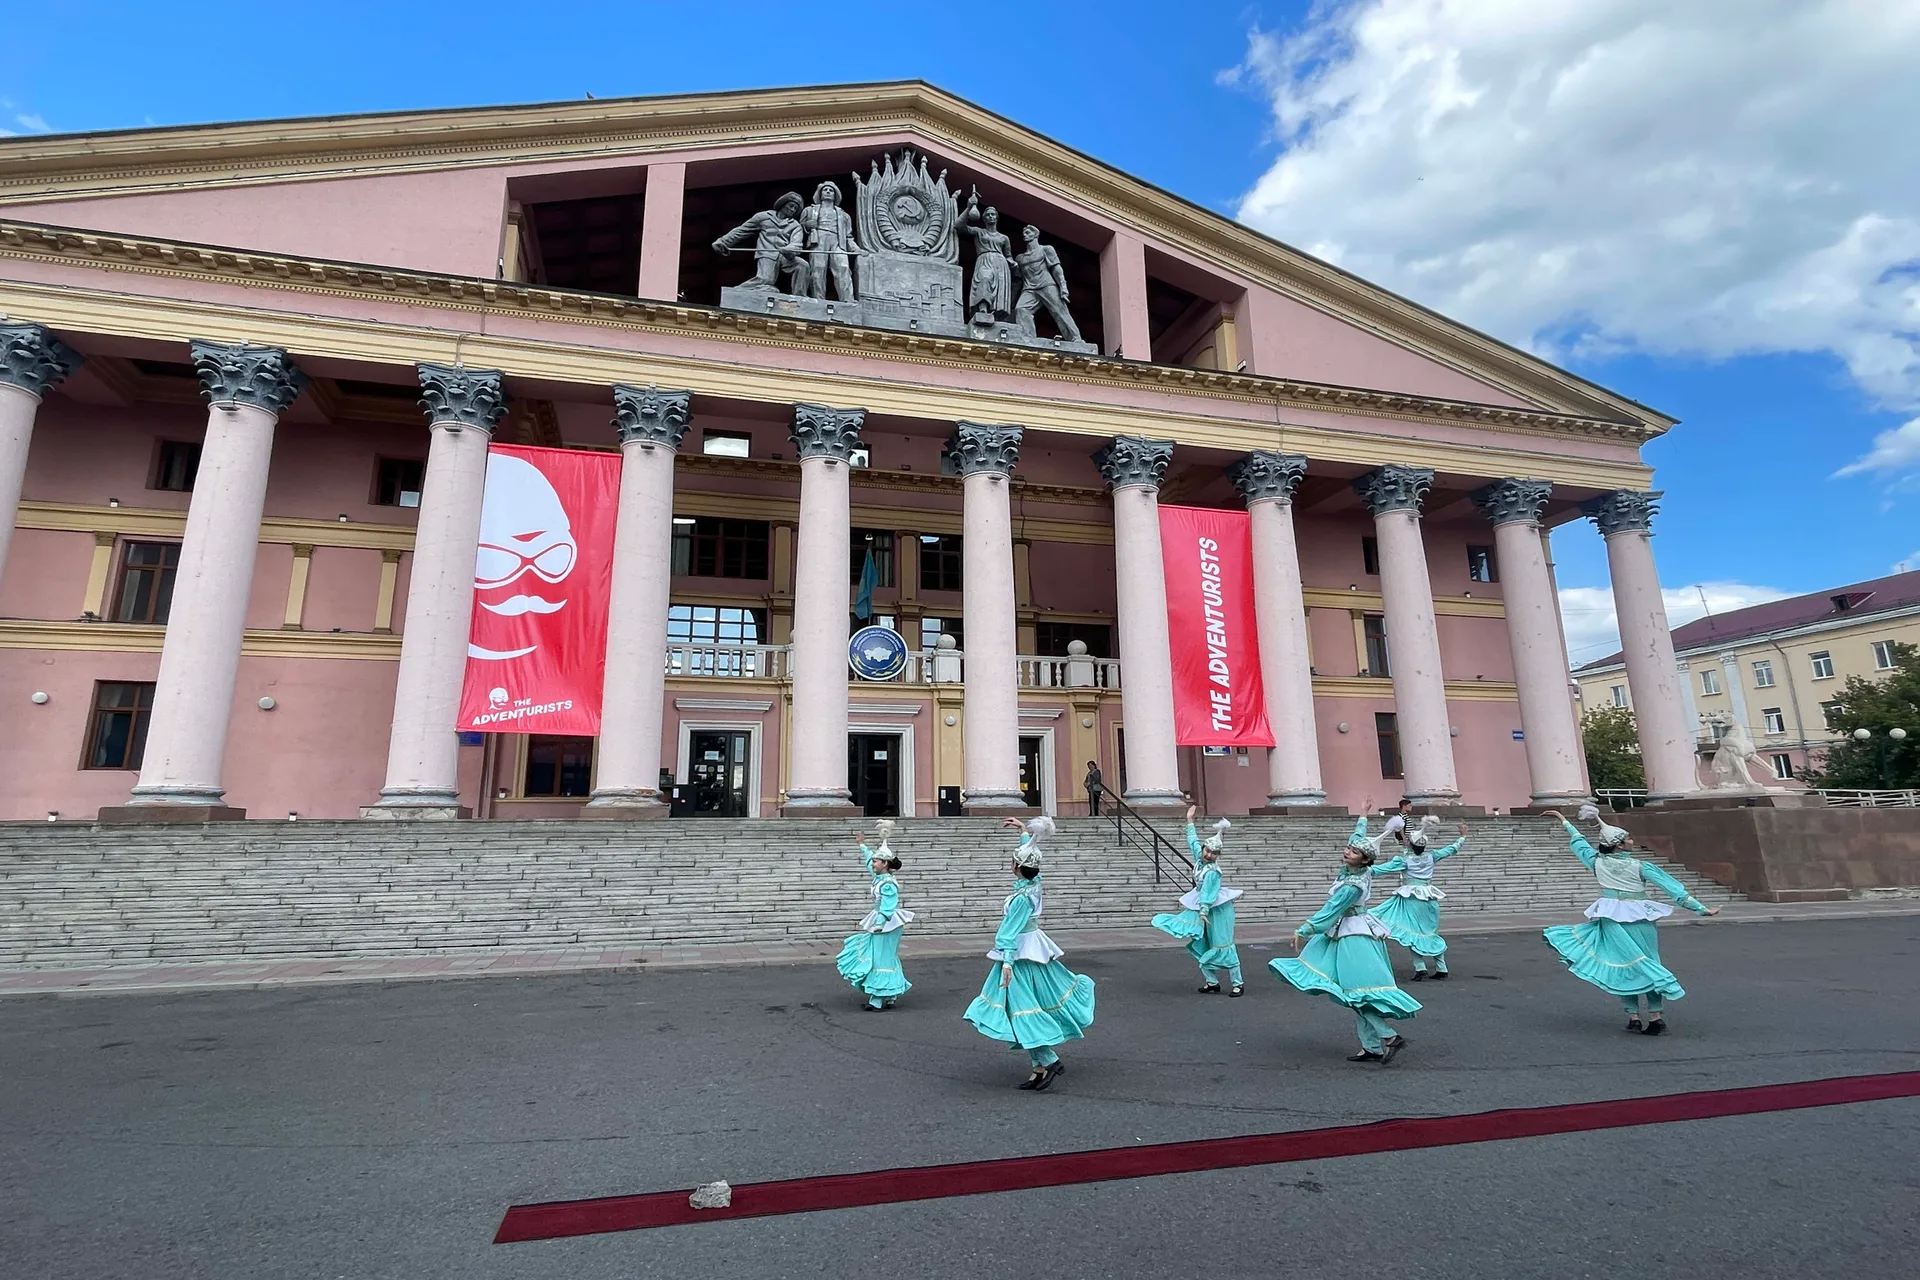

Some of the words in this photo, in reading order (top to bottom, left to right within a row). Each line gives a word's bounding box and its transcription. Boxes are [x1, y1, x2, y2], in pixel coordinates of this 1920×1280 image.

[1199, 537, 1230, 688] ADVENTURISTS
[472, 700, 572, 726] ADVENTURISTS
[514, 698, 532, 707] THE
[1210, 690, 1232, 732] THE
